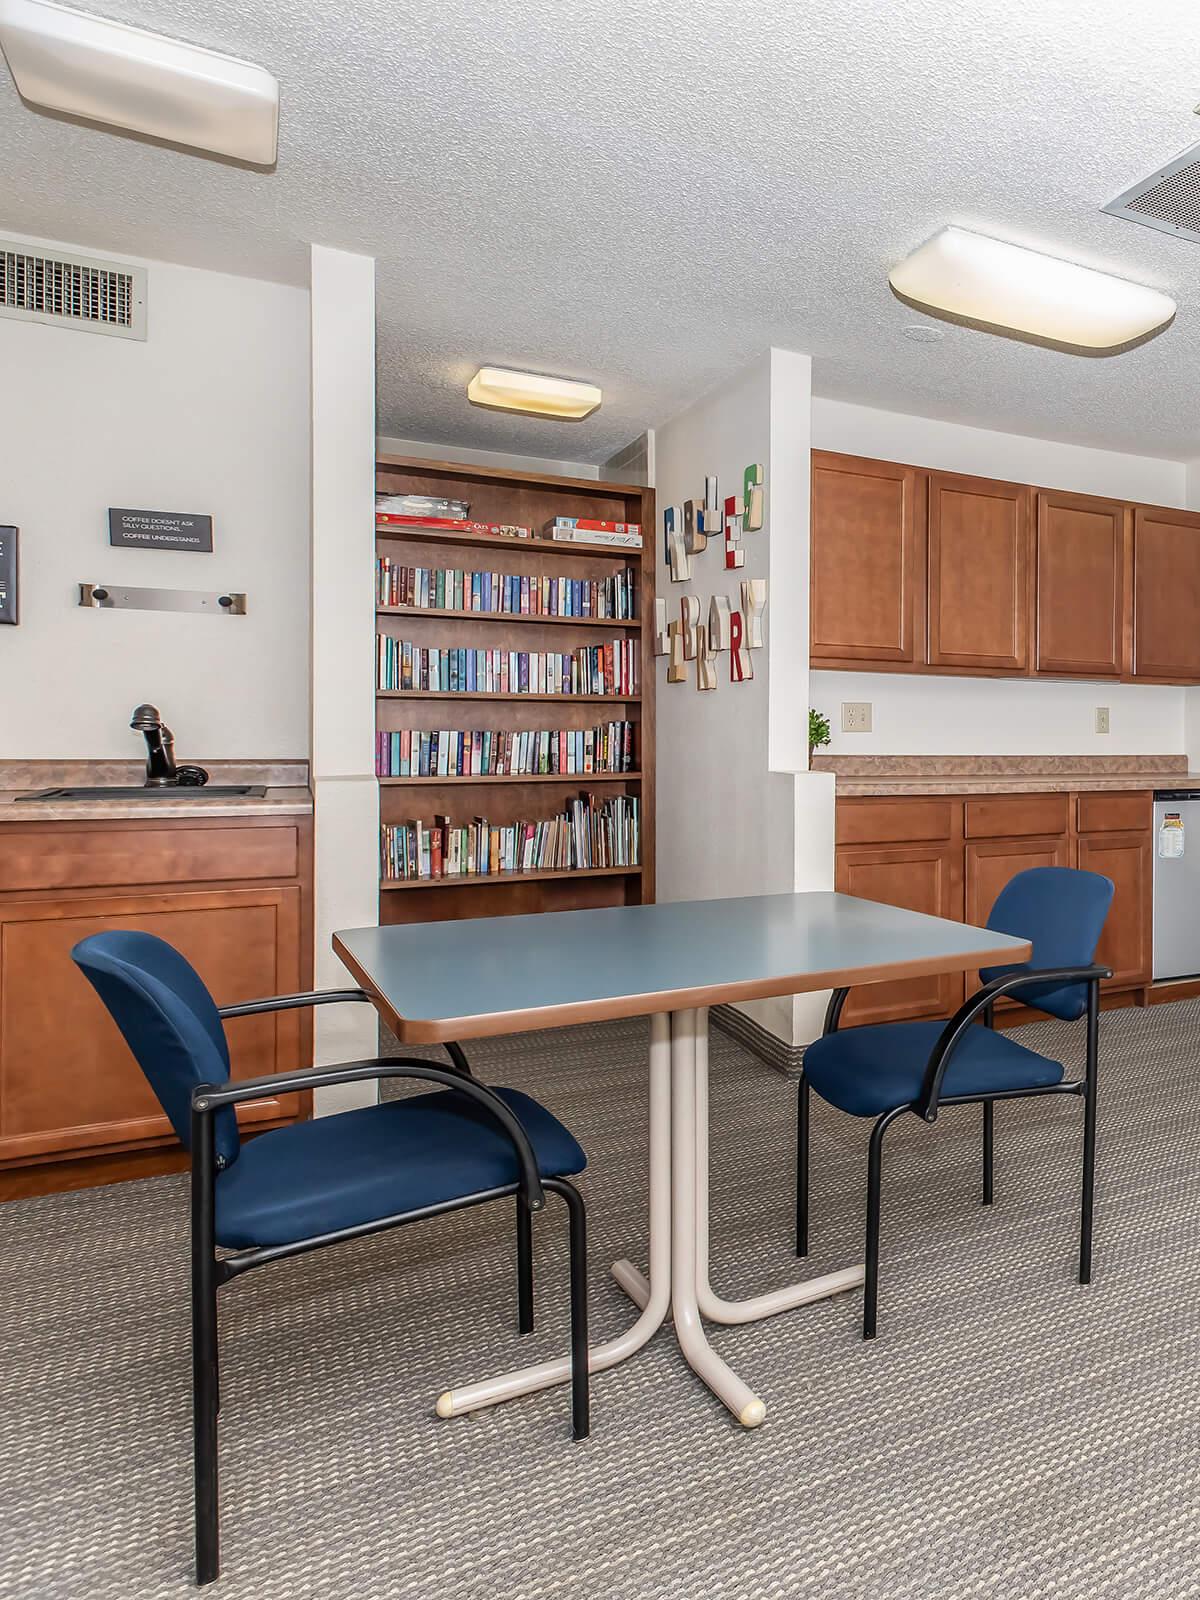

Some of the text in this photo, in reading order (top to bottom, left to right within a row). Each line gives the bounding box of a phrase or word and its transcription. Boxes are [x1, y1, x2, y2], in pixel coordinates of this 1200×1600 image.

[122, 516, 150, 524] COFFEE
[122, 532, 150, 540] COFFEE
[654, 577, 768, 690] LIBRARY
